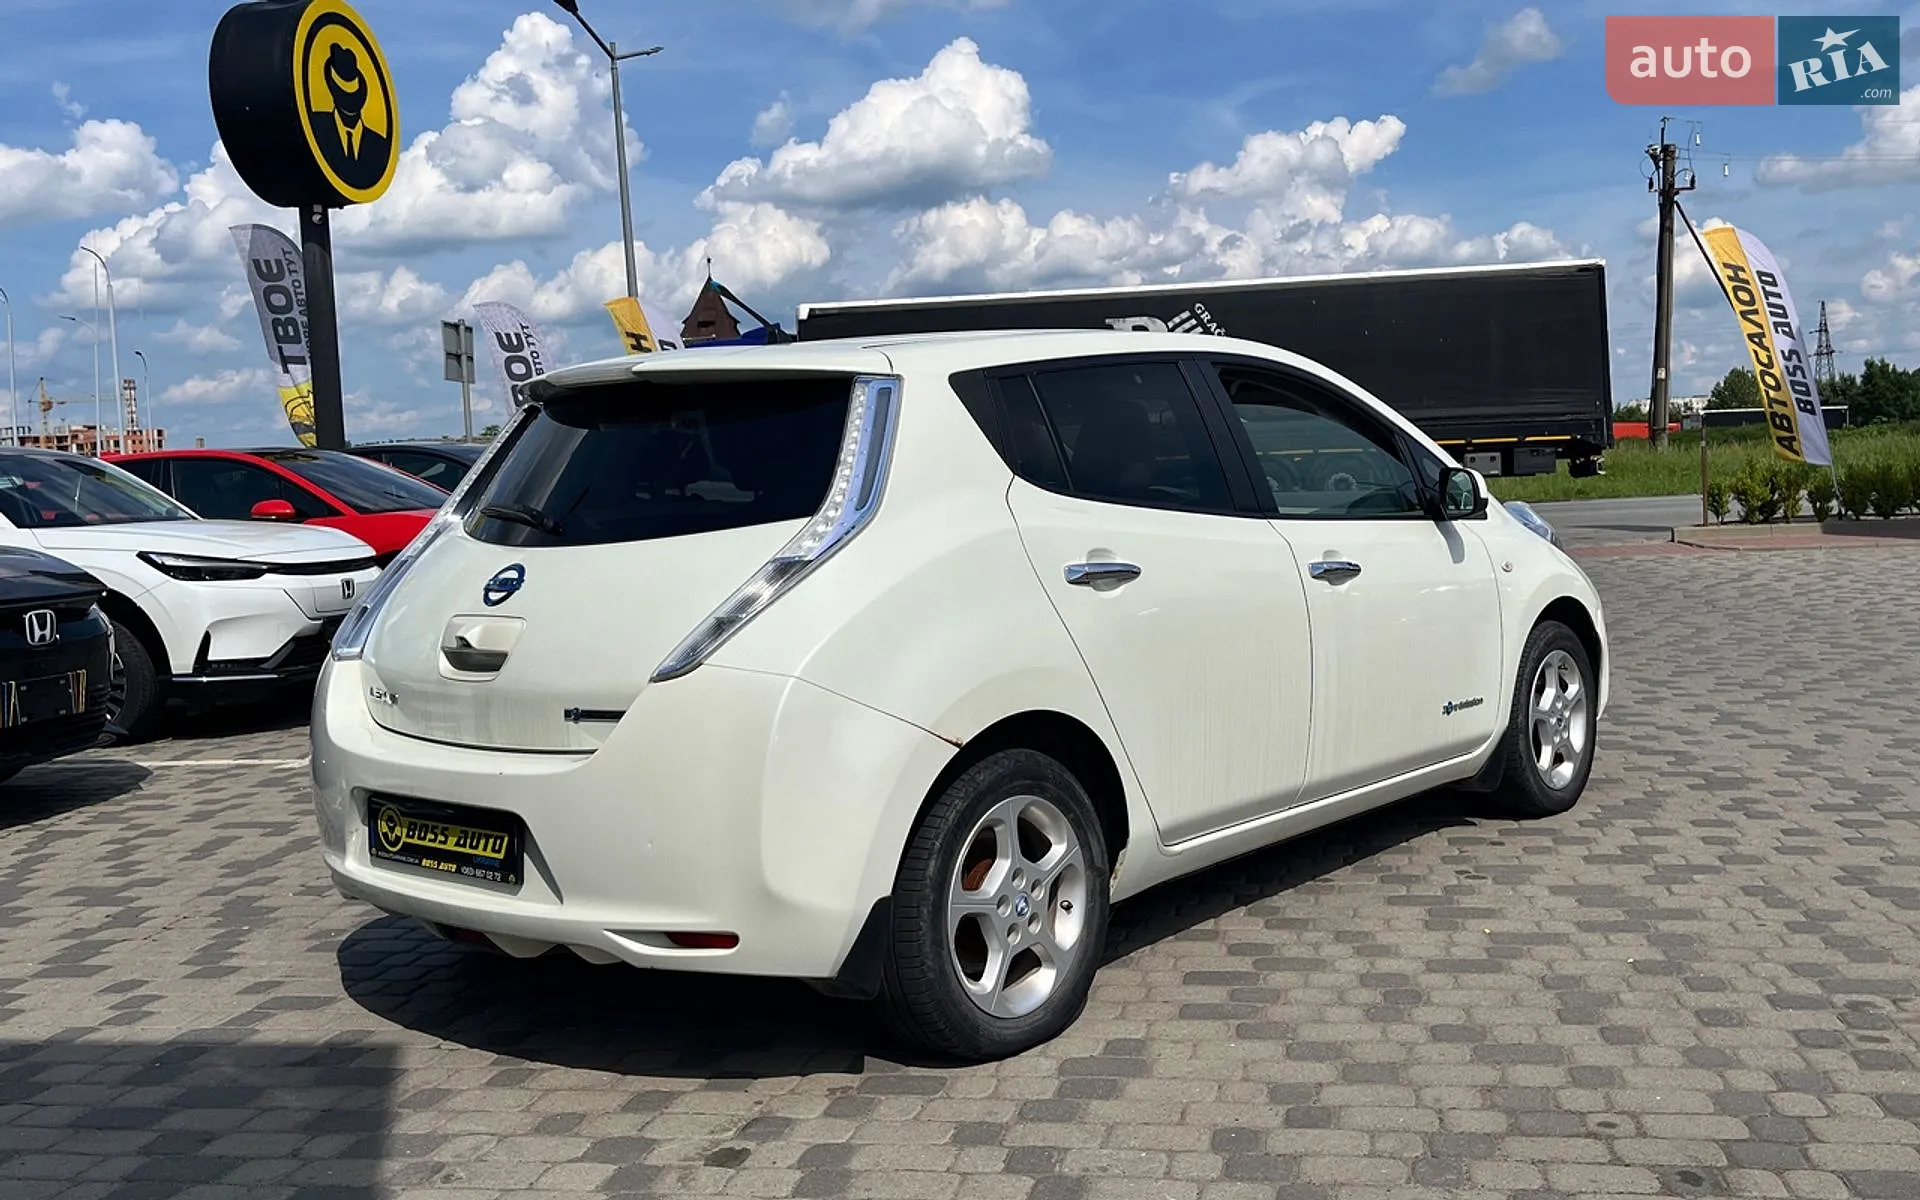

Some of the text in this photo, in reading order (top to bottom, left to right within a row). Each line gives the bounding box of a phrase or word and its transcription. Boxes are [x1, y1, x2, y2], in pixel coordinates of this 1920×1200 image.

[281, 248, 298, 278] ТУТ
[1722, 262, 1801, 457] АВТОСАЛОН
[1781, 348, 1817, 417] BOSS
[405, 820, 506, 854] BOSS AUTO
